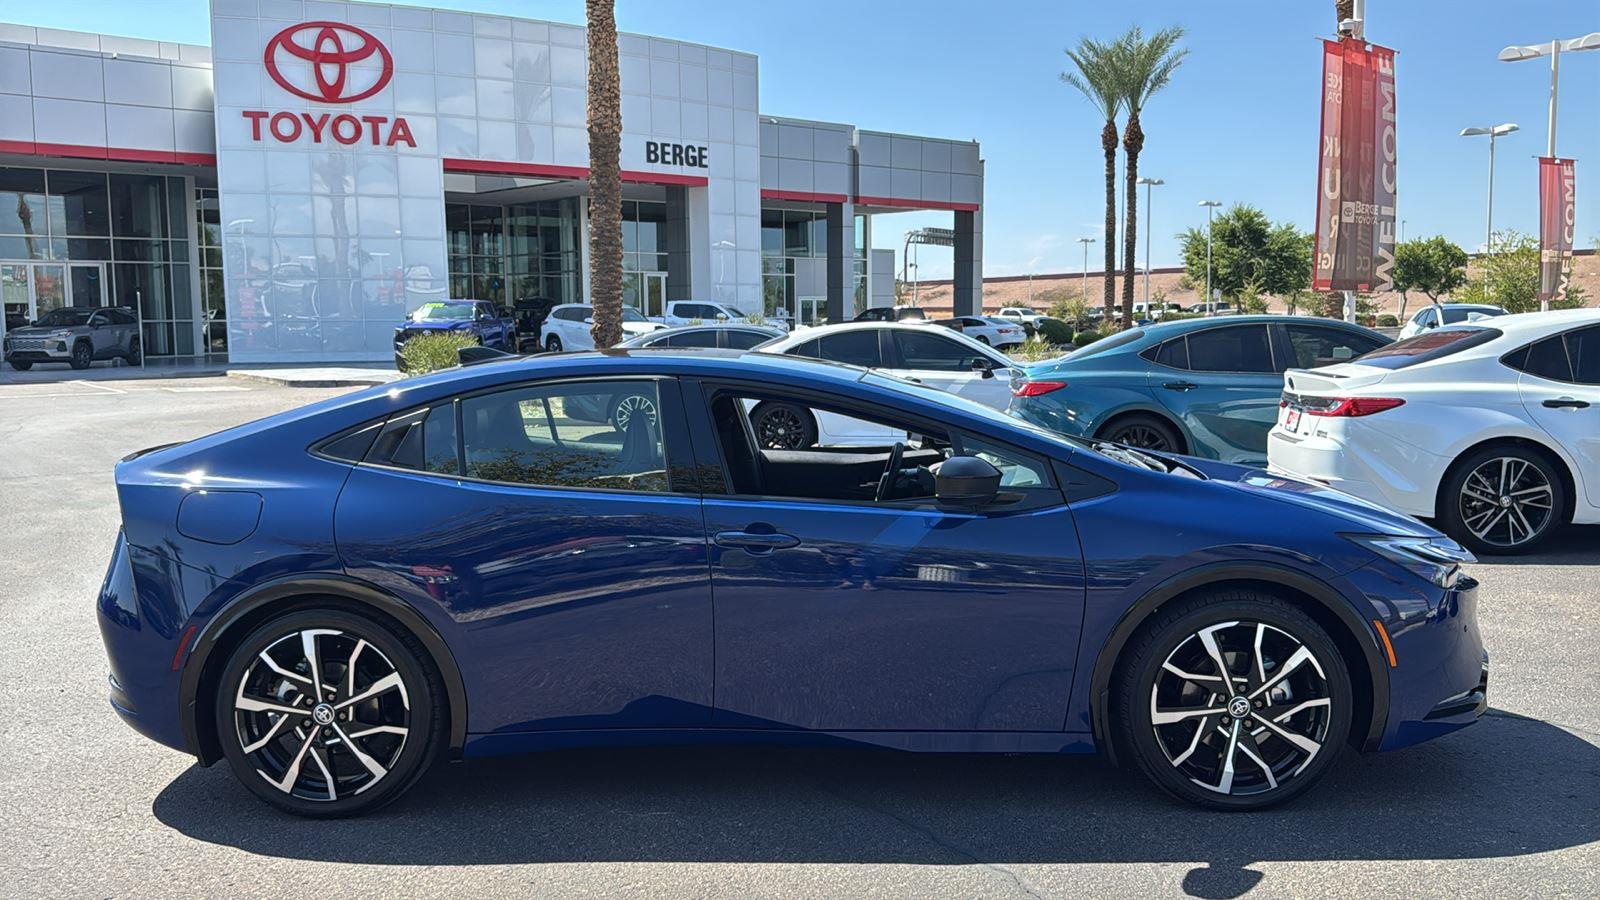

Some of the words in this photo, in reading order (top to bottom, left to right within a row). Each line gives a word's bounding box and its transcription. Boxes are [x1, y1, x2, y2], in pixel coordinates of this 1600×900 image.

[242, 111, 417, 147] TOYOTA
[646, 141, 708, 168] BERGE
[1355, 215, 1379, 225] TOYOTA
